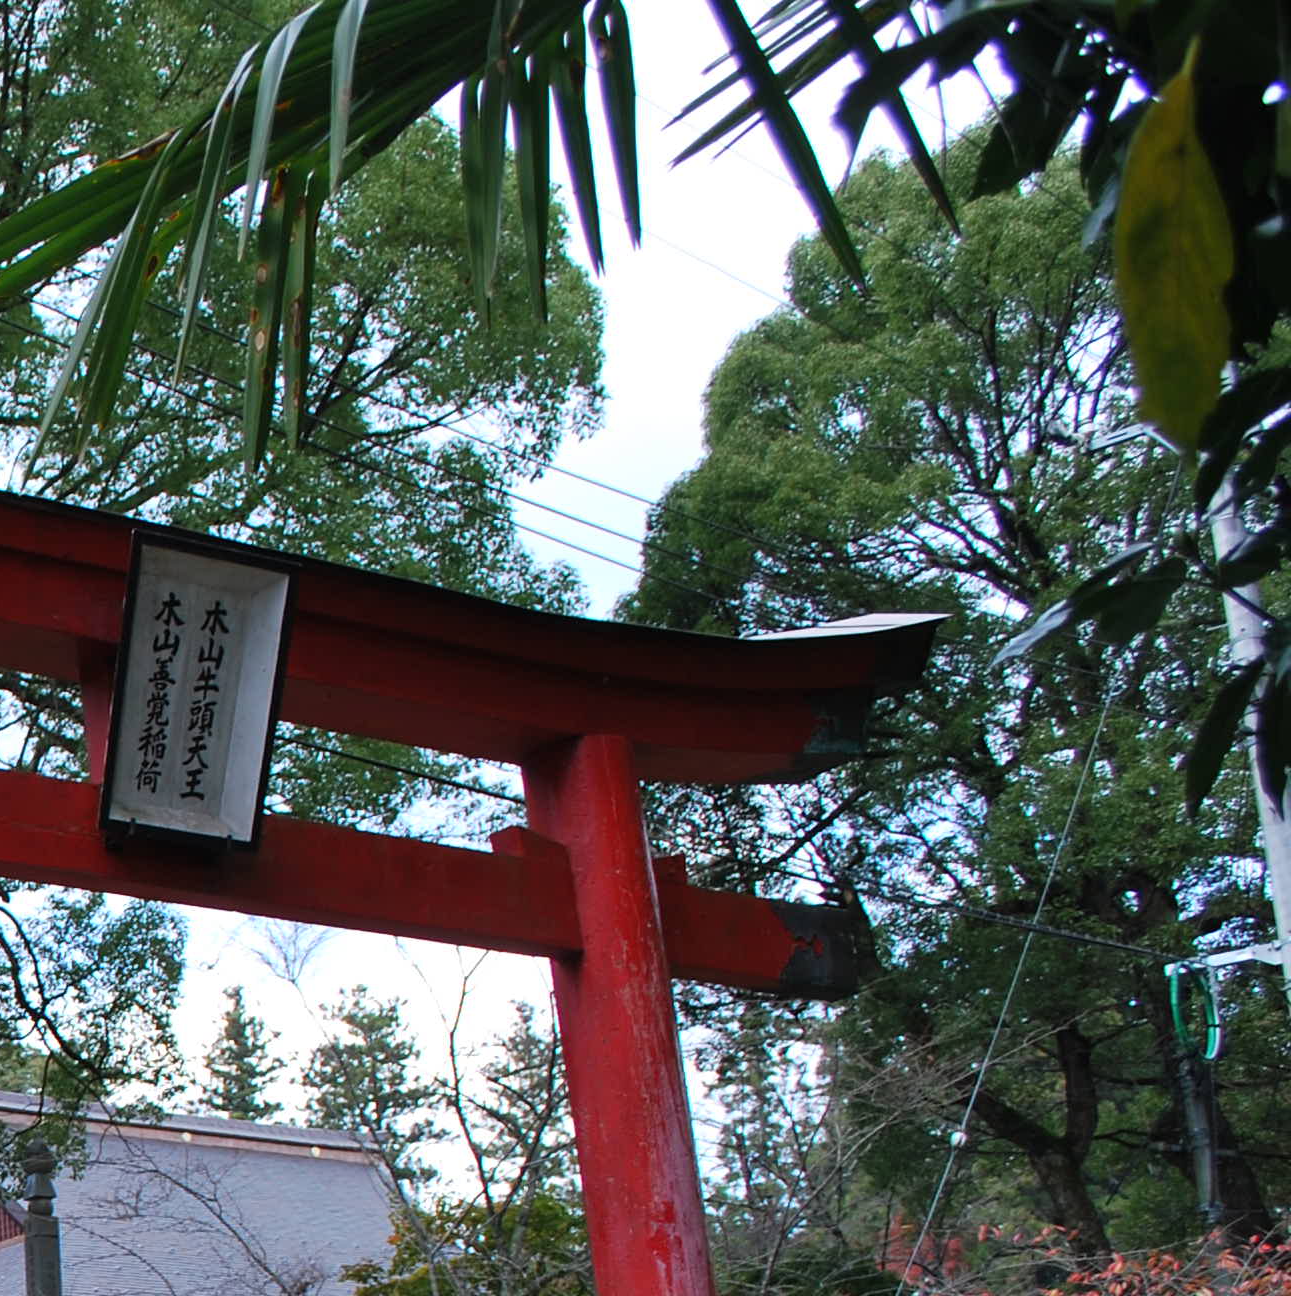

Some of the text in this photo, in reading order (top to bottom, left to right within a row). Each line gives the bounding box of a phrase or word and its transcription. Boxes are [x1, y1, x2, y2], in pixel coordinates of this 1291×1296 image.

[135, 592, 185, 794] 木山善覚稲荷
[180, 600, 229, 801] 木山牛頭天王
